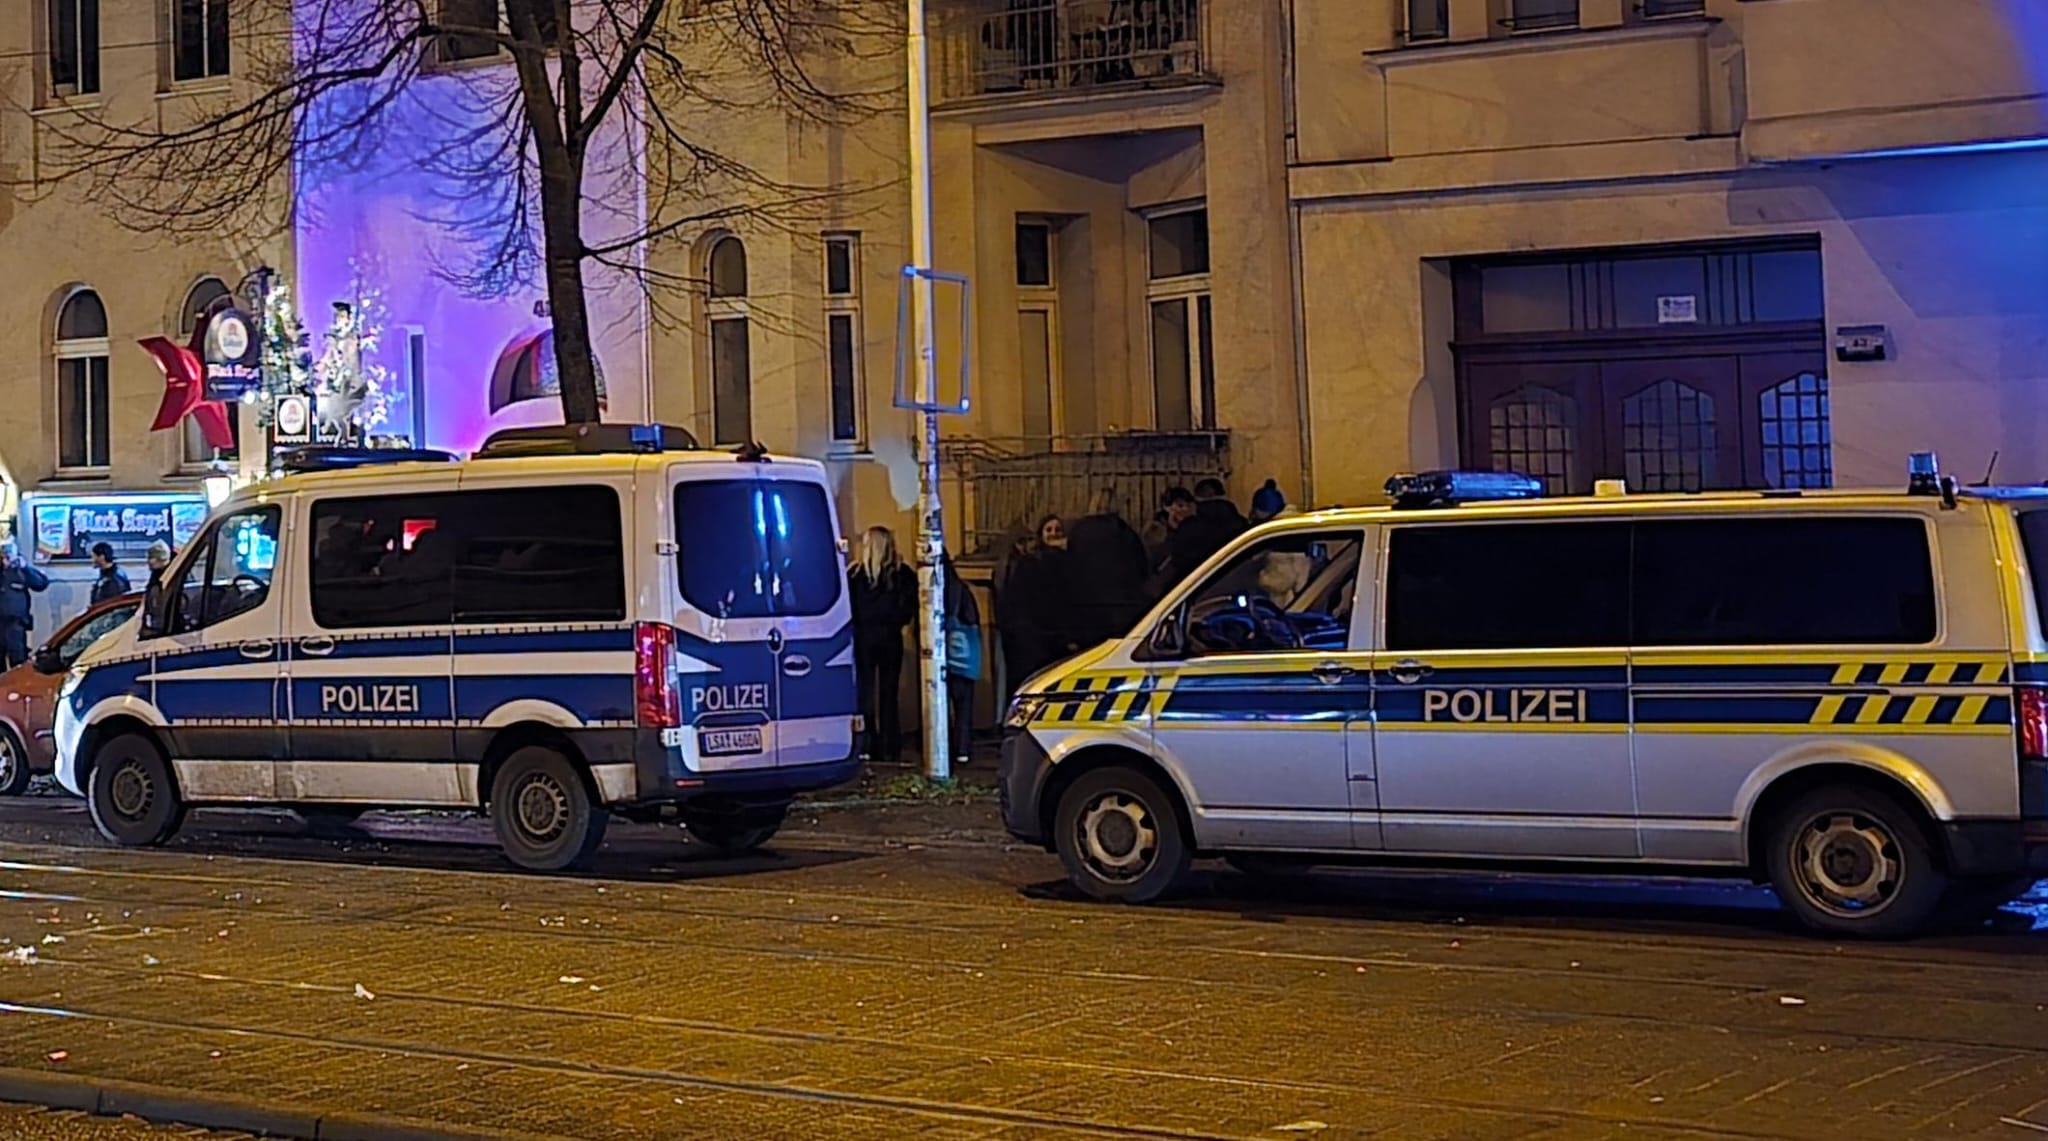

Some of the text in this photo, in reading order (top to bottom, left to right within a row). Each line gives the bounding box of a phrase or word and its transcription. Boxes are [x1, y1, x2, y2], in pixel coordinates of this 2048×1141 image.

[321, 685, 419, 712] POLIZEI
[691, 683, 769, 712] POLIZEI
[1424, 689, 1586, 722] POLIZEI
